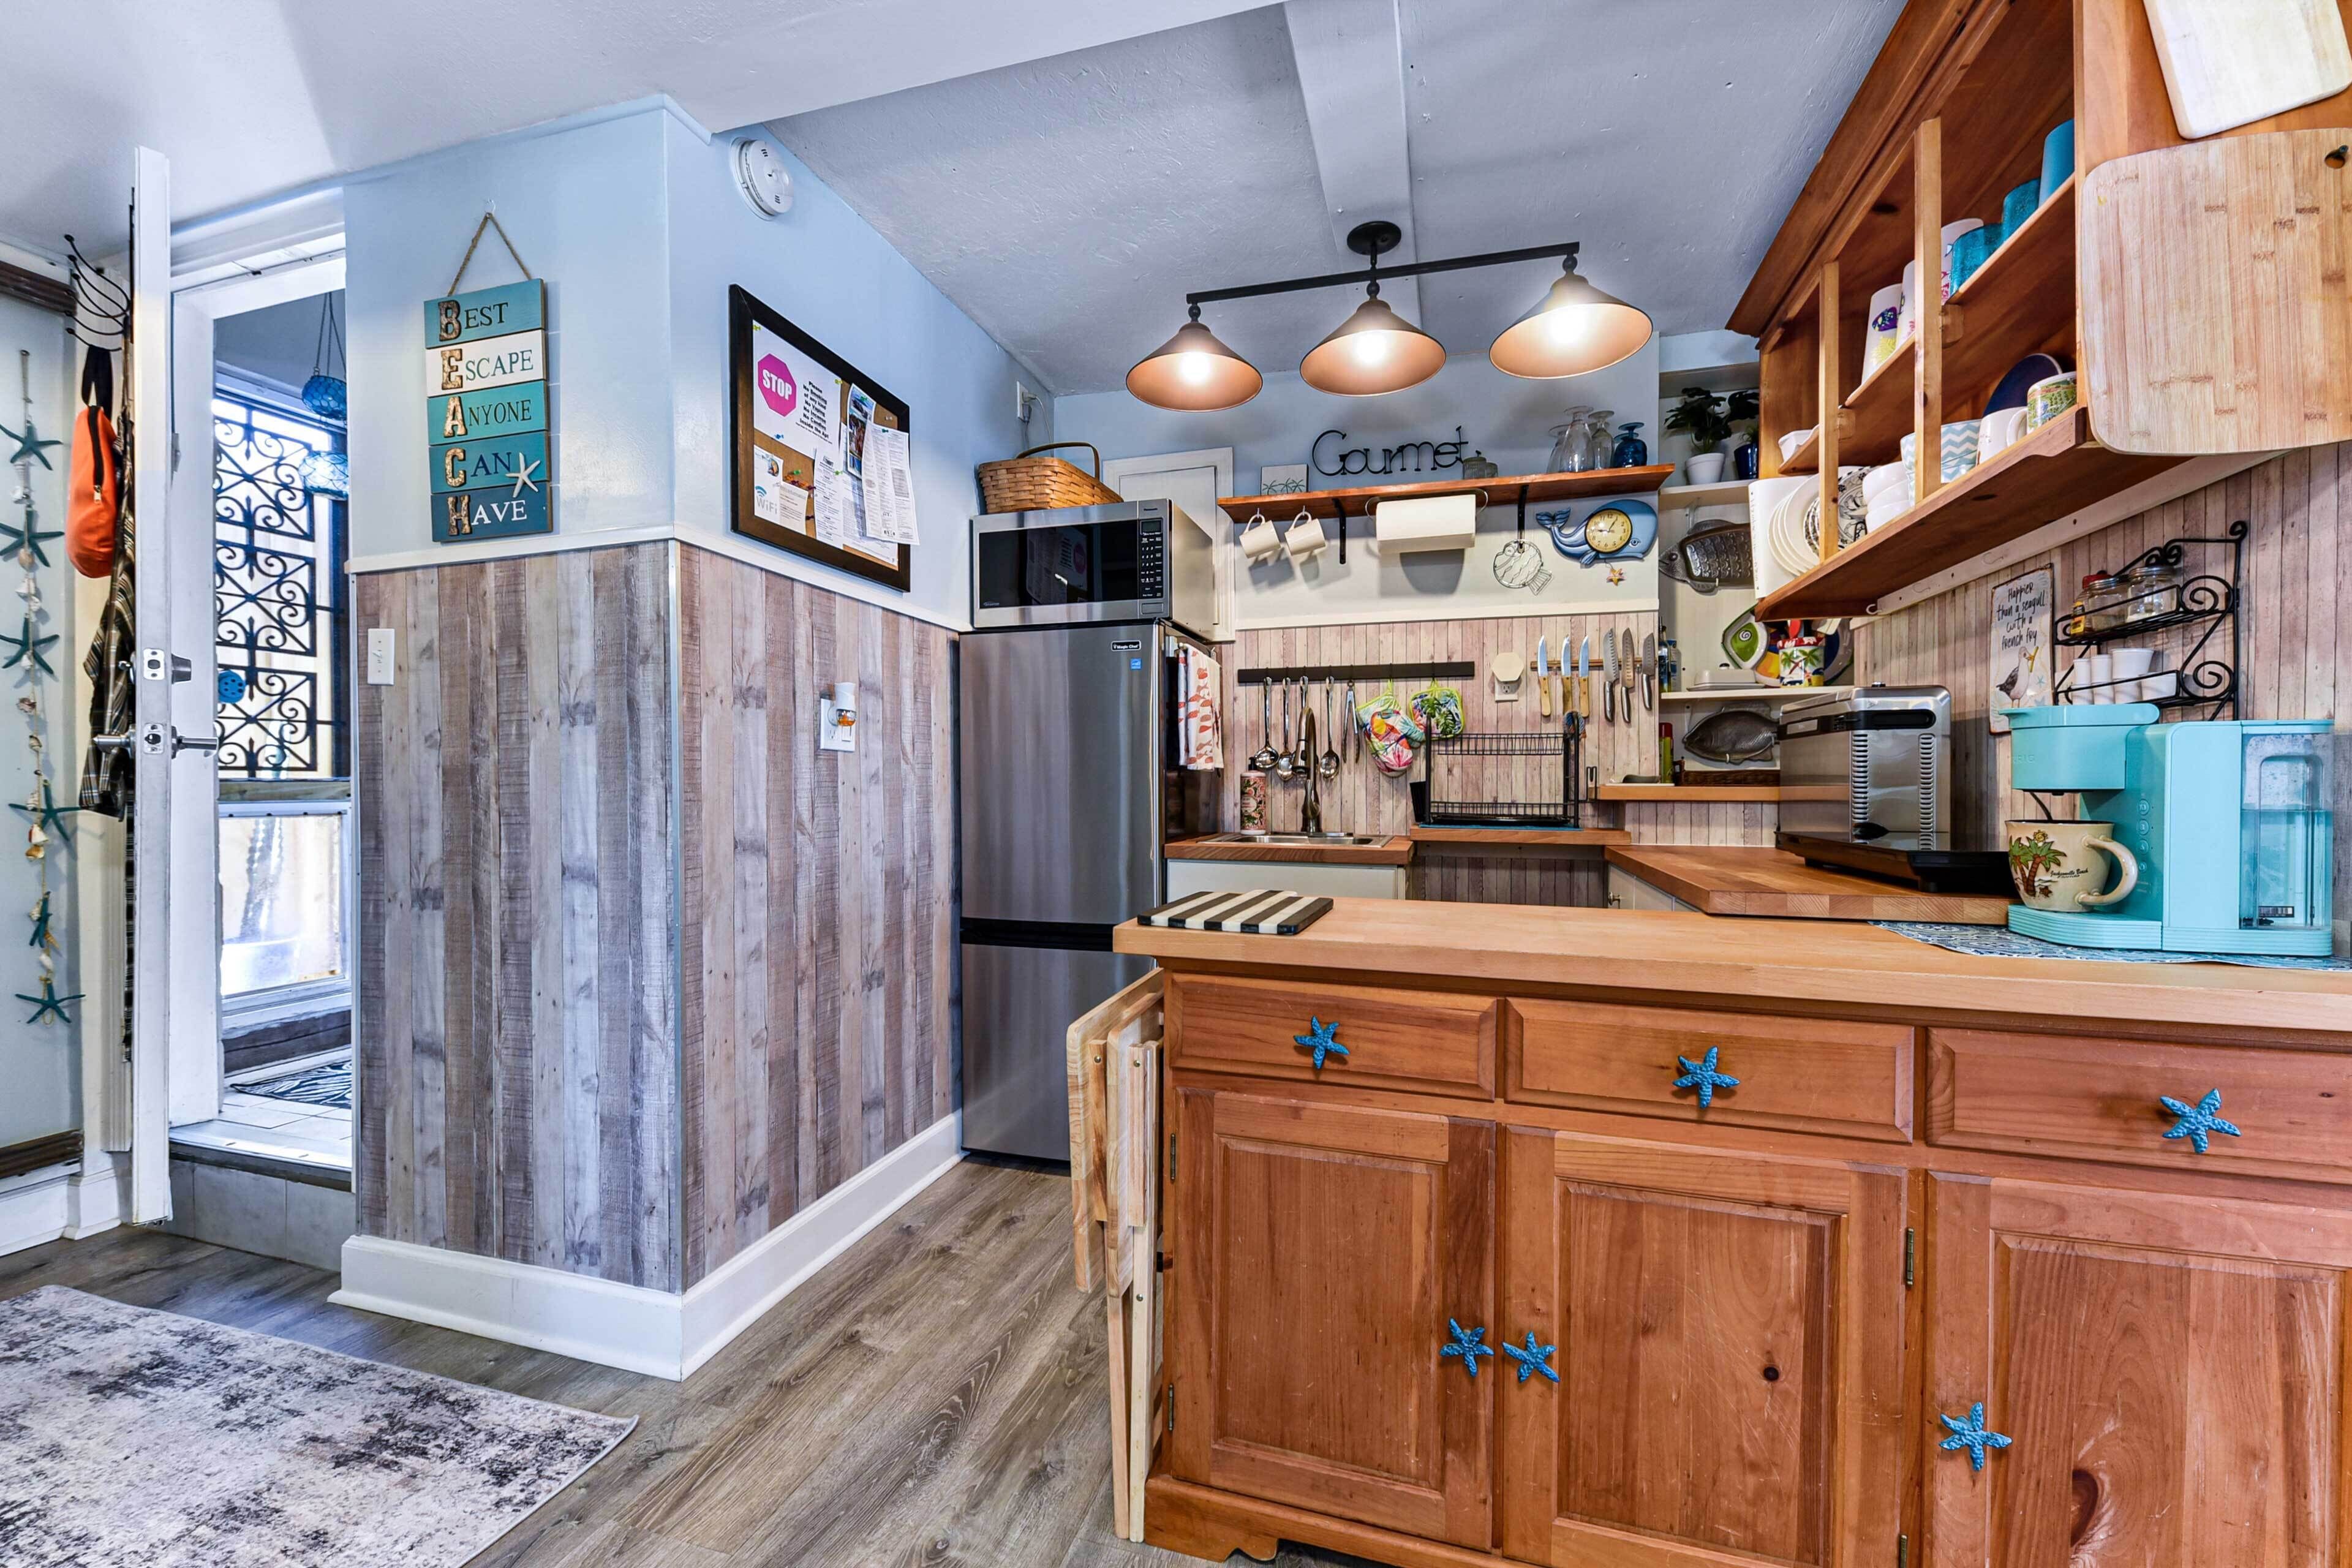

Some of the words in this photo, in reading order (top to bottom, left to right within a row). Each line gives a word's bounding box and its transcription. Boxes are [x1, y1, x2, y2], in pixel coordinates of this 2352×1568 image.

[438, 300, 509, 342] BEST
[440, 348, 534, 391] ESCAPE
[762, 369, 793, 401] STOP
[443, 396, 532, 439] ANYONE
[445, 448, 512, 488] CAN
[1312, 425, 1469, 476] Gourmet
[447, 494, 527, 536] HAVE
[755, 495, 778, 515] WiFi
[1997, 604, 2013, 621] than
[2022, 590, 2045, 615] seagull
[2006, 612, 2026, 633] with
[2002, 630, 2023, 650] french
[2026, 627, 2038, 646] fry
